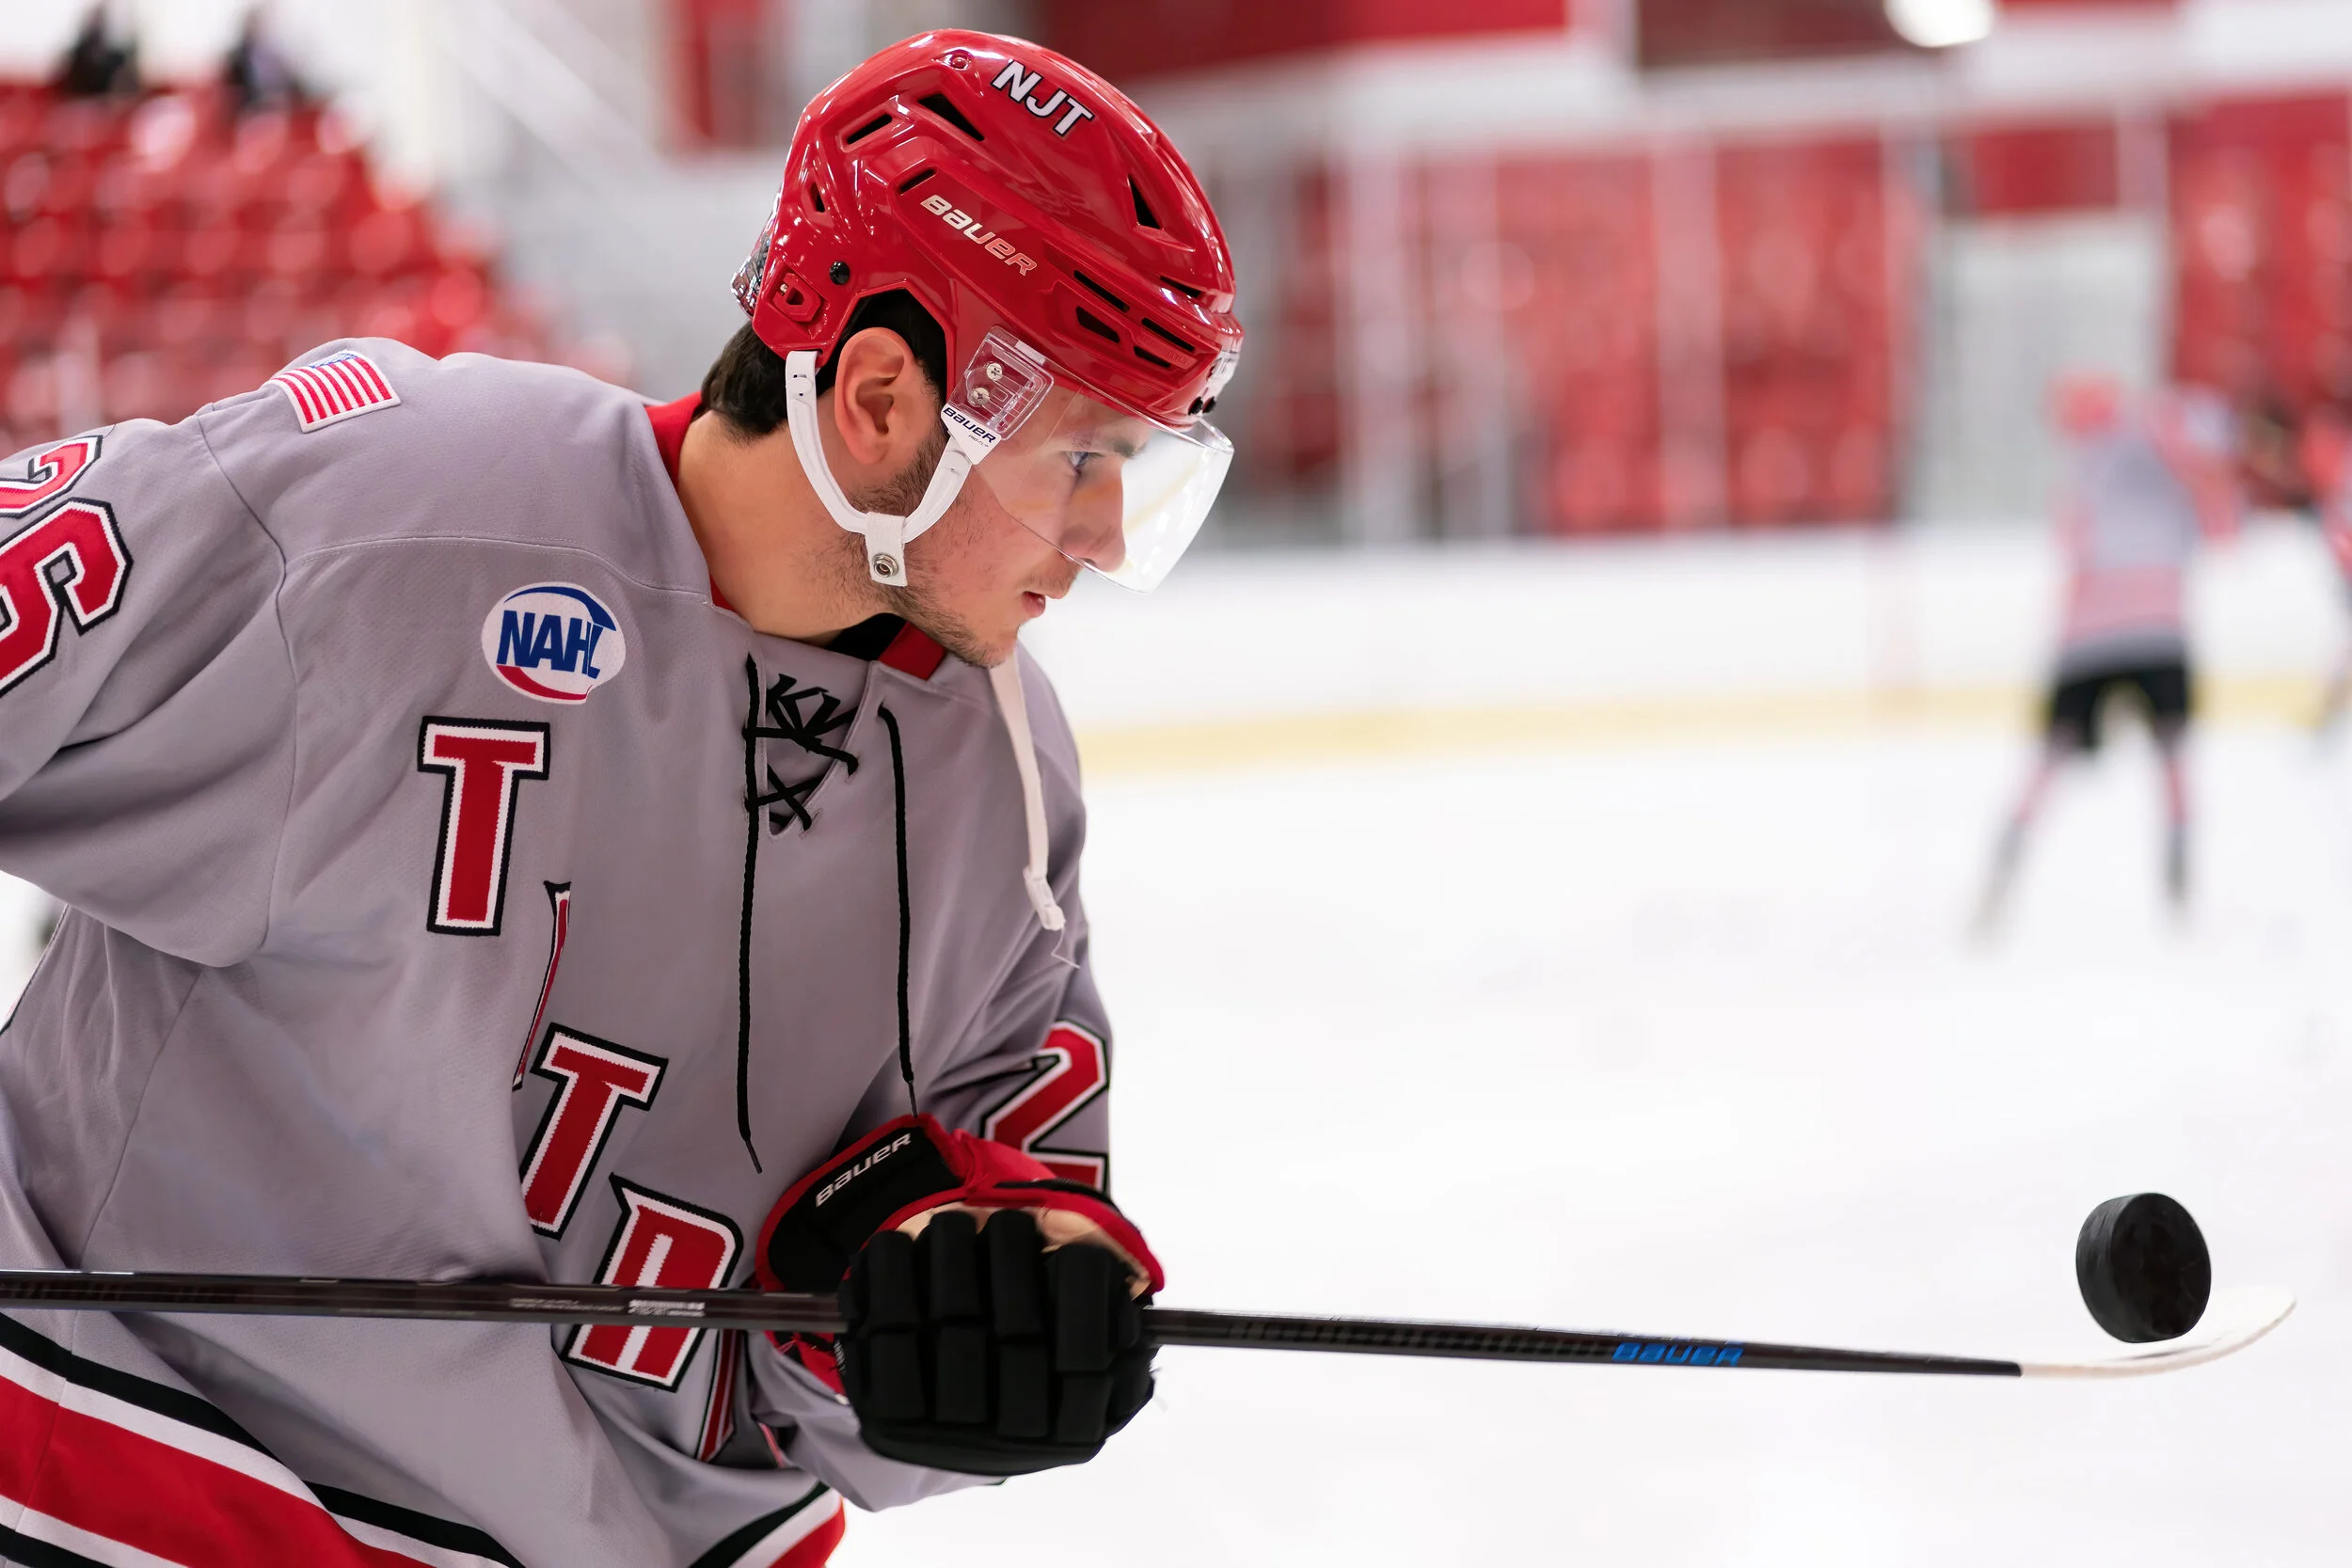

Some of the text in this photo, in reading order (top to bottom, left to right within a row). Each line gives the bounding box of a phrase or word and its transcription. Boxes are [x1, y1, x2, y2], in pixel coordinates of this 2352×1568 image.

[990, 59, 1096, 137] NJT
[920, 194, 1038, 277] BAUER
[943, 406, 996, 443] BAUER
[496, 610, 604, 680] NAHL
[815, 1132, 912, 1208] BAUER
